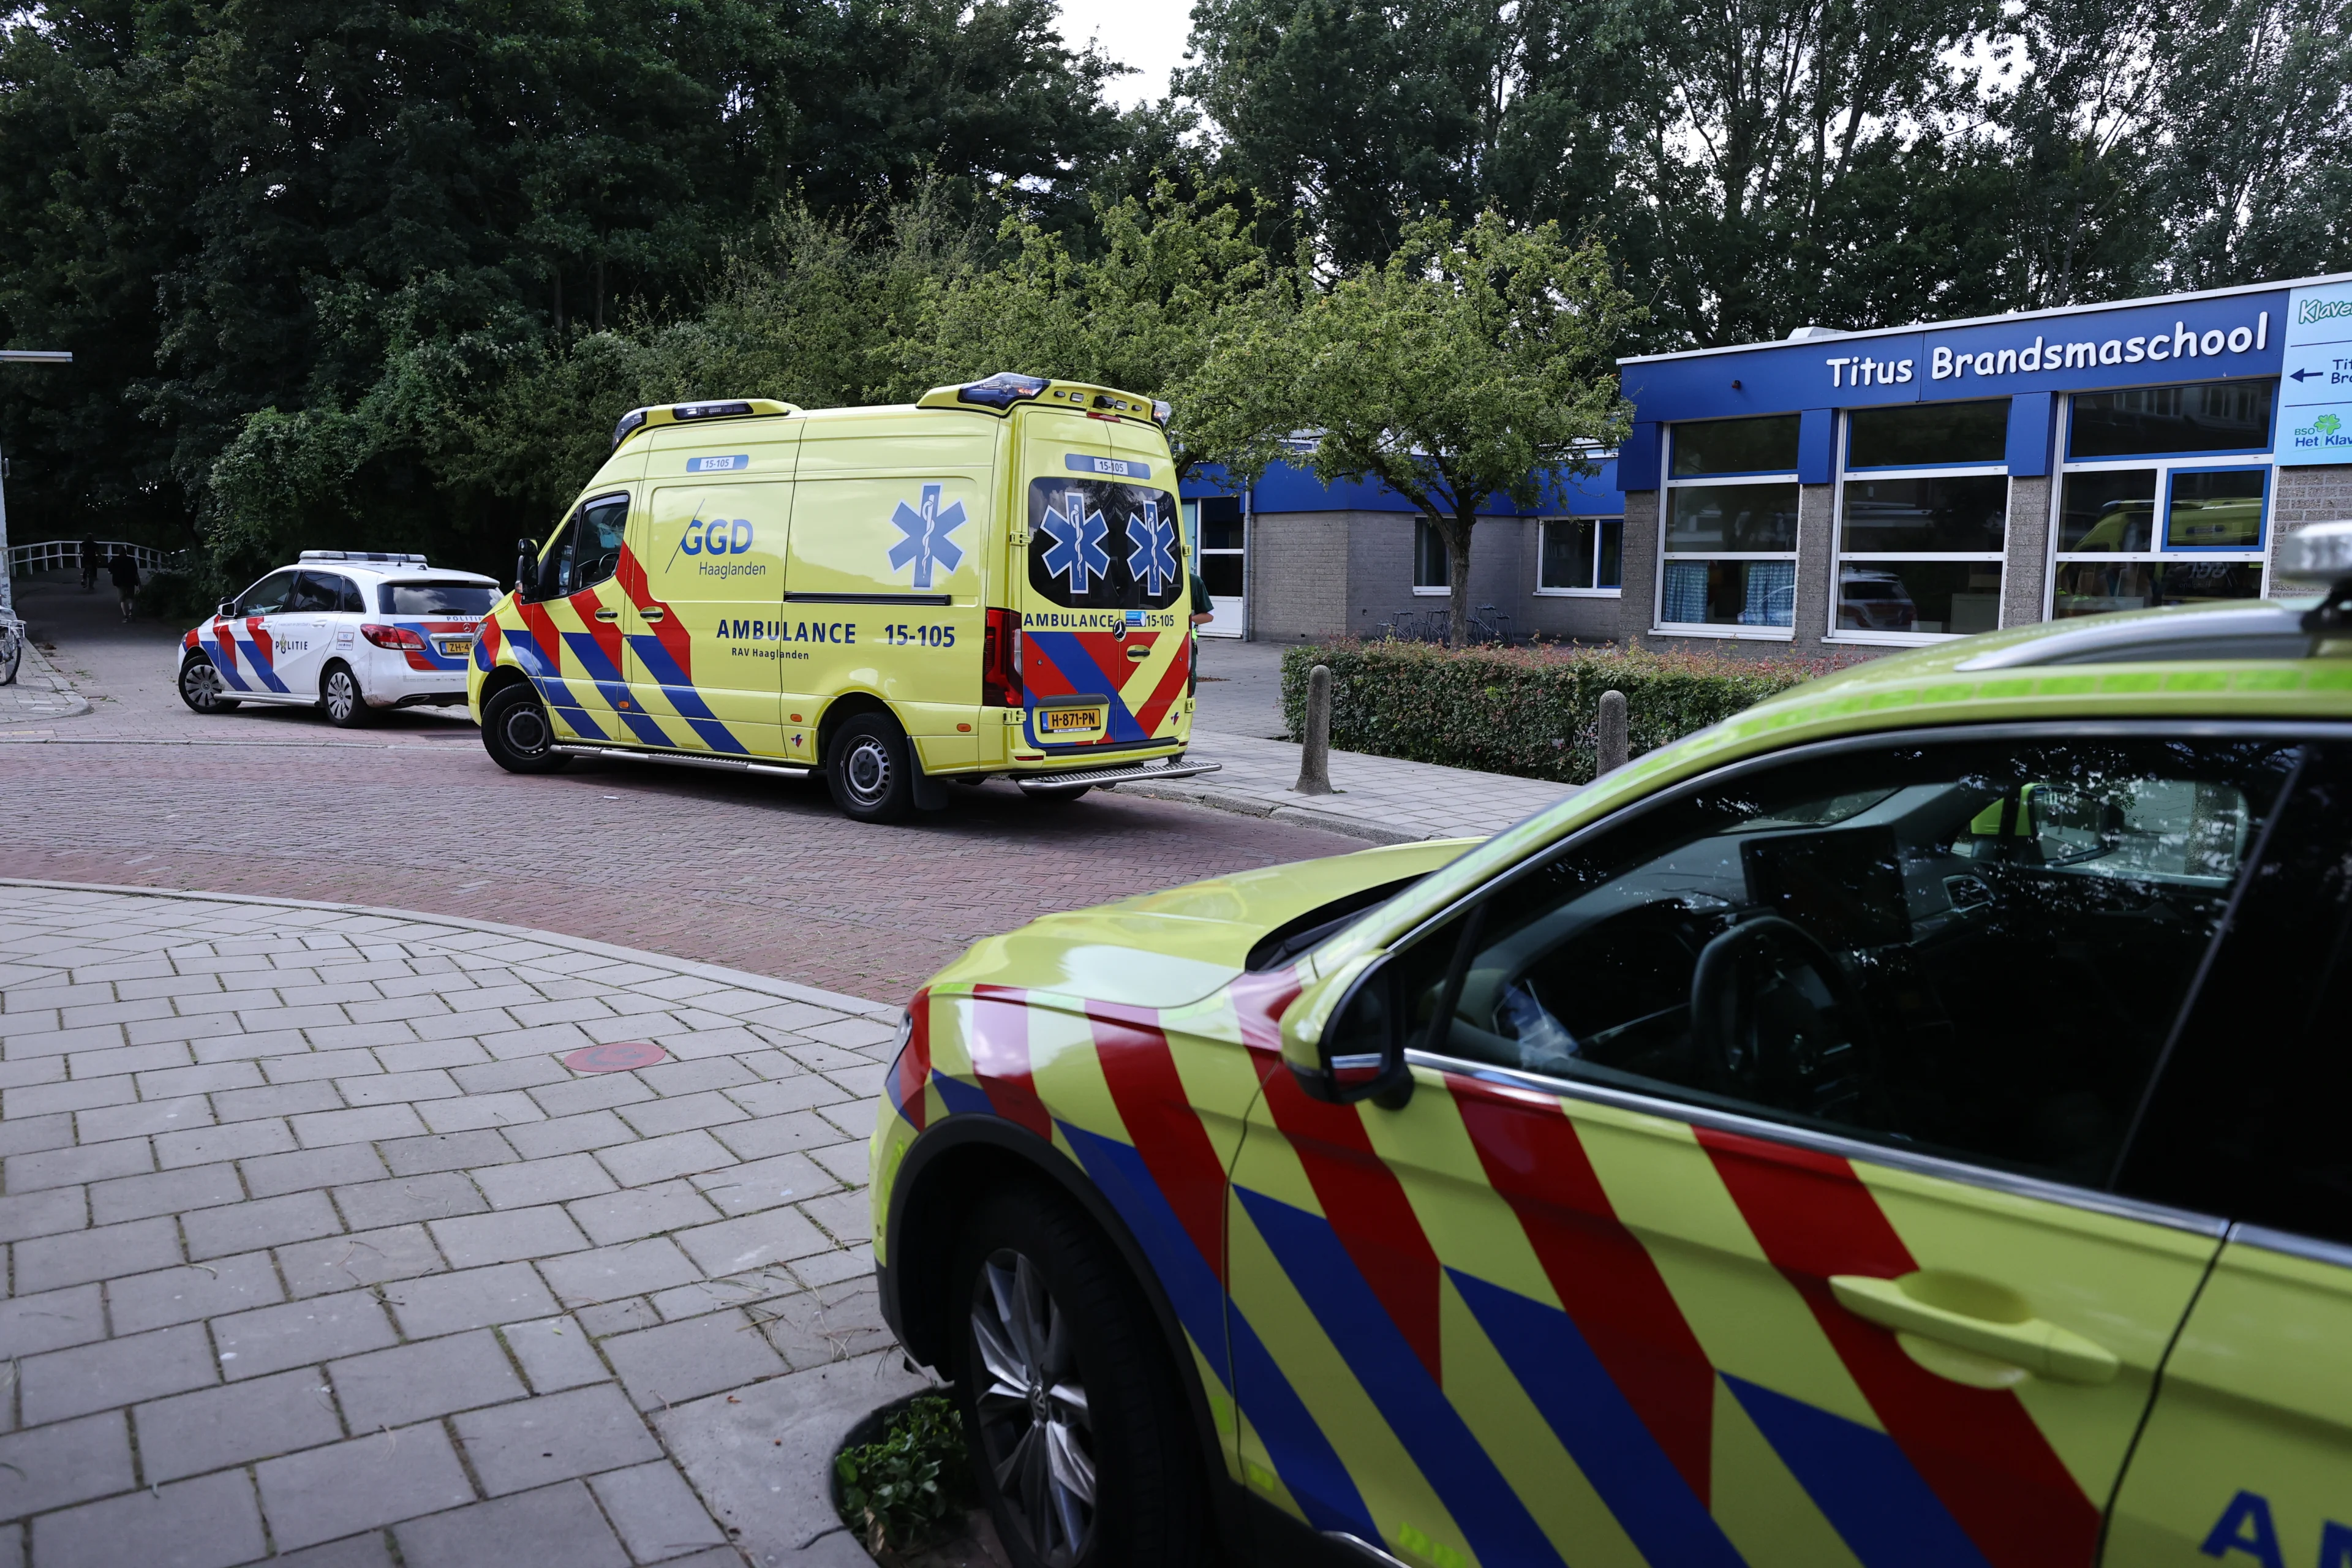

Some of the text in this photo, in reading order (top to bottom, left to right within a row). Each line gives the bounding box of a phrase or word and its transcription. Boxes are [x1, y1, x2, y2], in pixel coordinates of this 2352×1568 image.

[2299, 299, 2352, 325] Klave
[1826, 311, 2268, 387] Titus Brandsmaschool
[2295, 436, 2319, 447] Het
[705, 459, 729, 468] 15-105
[1099, 461, 1123, 472] 15-105
[681, 519, 753, 556] GGD
[699, 561, 766, 579] Haaglanden
[1023, 613, 1114, 628] AMBULANCE
[1146, 614, 1174, 627] 15-105
[716, 619, 955, 647] AMBULANCE 15-105
[276, 640, 307, 654] POLITIE
[449, 643, 472, 652] ZH-4
[731, 647, 809, 660] RAV Haaglanden
[1052, 712, 1095, 727] H-871-PN
